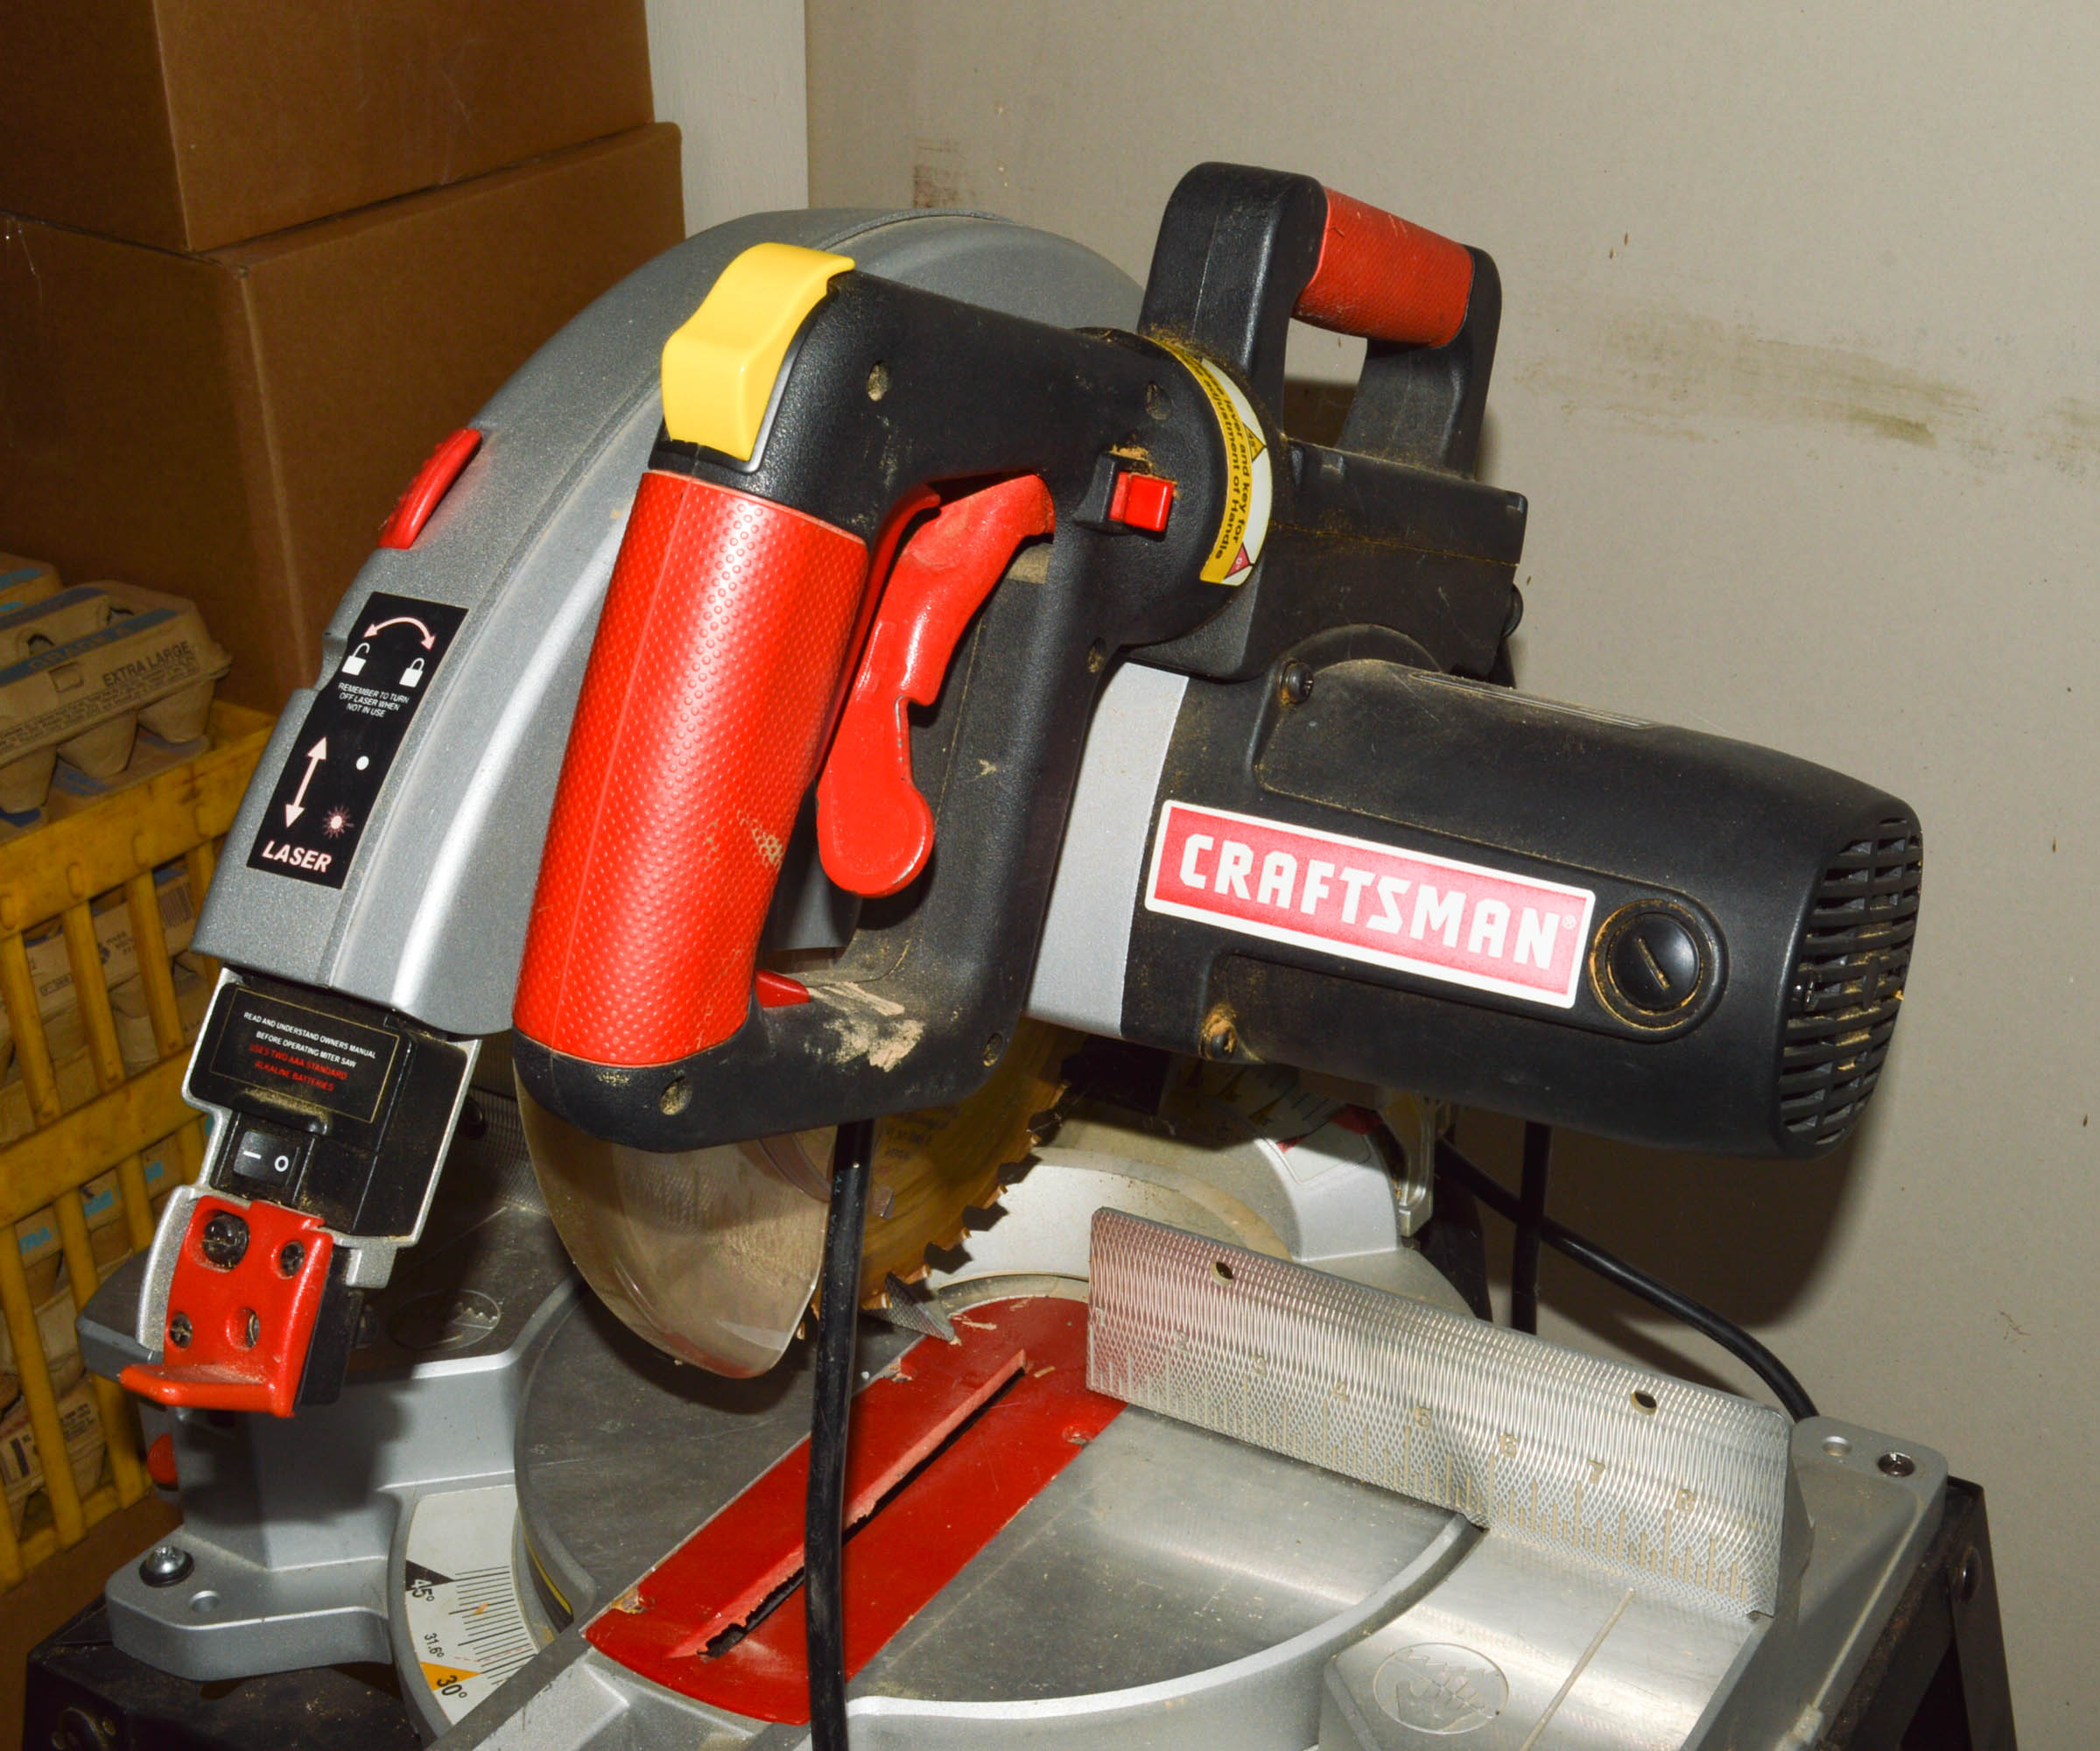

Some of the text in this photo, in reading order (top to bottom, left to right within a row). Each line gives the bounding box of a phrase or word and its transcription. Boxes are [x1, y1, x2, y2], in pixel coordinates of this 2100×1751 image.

[1225, 399, 1250, 544] lever and key for
[1233, 476, 1240, 493] of
[1215, 499, 1239, 560] Handle
[102, 660, 147, 687] EXTRA
[145, 640, 189, 669] LARGE
[338, 682, 379, 698] REMEMBER
[390, 693, 410, 704] TURN
[339, 692, 401, 711] OFF LASER WHEN
[346, 702, 386, 718] NOT IN USE
[262, 840, 332, 873] LASER
[243, 1011, 376, 1059] READ AND UNDERSTAND OWNERS MANUAL
[256, 1030, 357, 1068] BEFORE OPERATING MITER SAW
[254, 1059, 334, 1092] ALKALINE BATTERIES
[288, 1054, 305, 1067] AAA
[306, 1060, 348, 1080] STANDARD
[1331, 1380, 1349, 1403] 4
[1414, 1404, 1432, 1430] 5
[1499, 1432, 1517, 1458] 6
[1587, 1459, 1606, 1485] 7
[1675, 1488, 1696, 1515] 8
